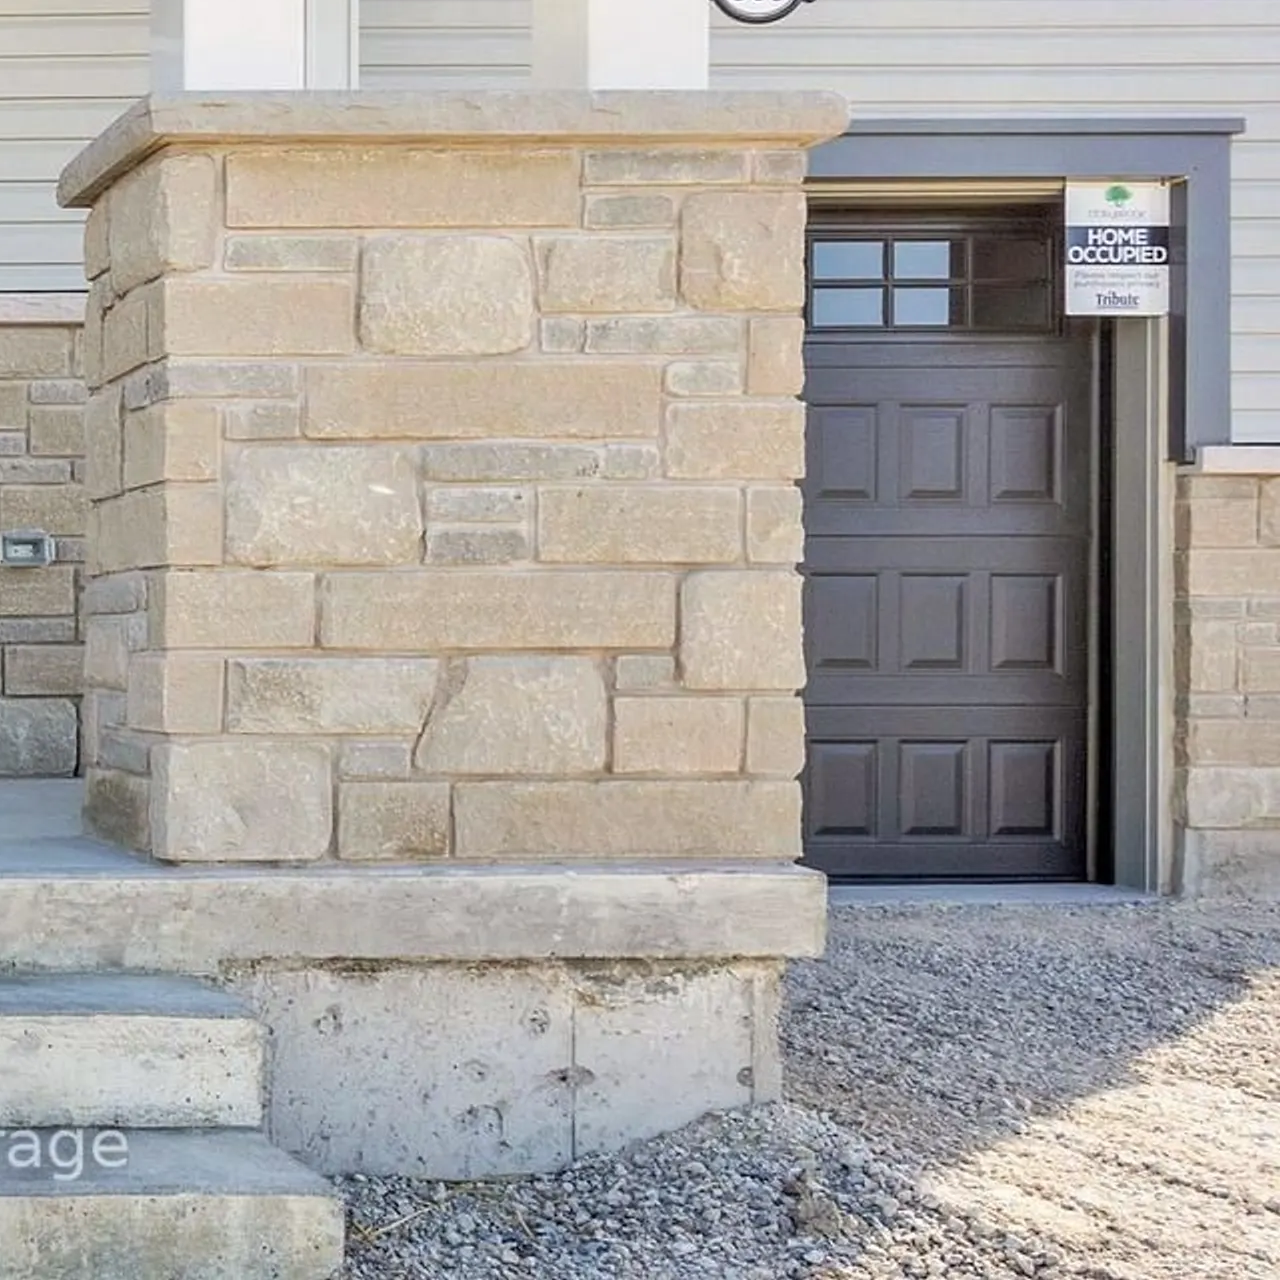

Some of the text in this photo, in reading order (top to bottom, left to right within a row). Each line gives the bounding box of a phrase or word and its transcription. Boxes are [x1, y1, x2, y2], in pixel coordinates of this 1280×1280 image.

[1088, 228, 1149, 245] HOME
[1068, 245, 1167, 263] OCCUPIED
[1096, 290, 1140, 305] Tribute
